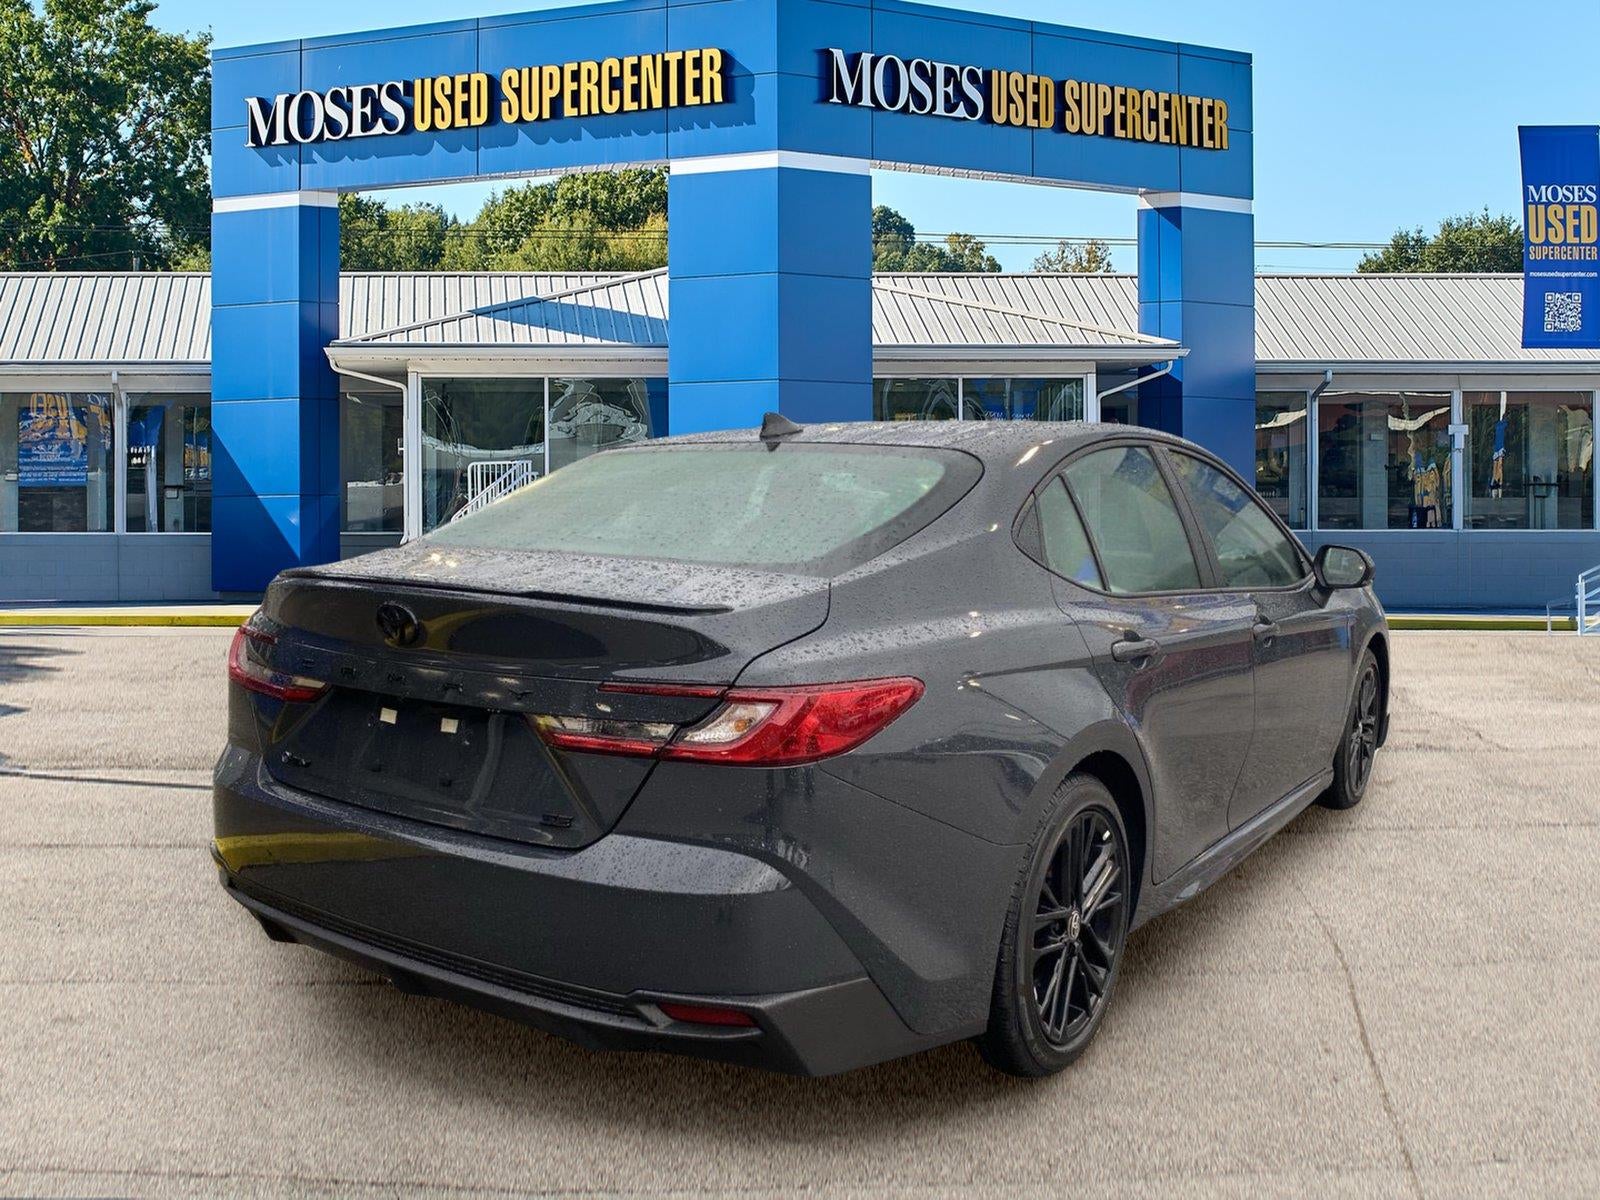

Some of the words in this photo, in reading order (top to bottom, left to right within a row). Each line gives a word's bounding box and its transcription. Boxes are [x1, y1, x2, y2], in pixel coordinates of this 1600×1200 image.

[244, 80, 406, 148] MOSES
[414, 72, 489, 132] USED
[500, 47, 725, 124] SUPERCENTER
[829, 48, 984, 121] MOSES
[991, 69, 1055, 129] USED
[1064, 79, 1229, 151] SUPERCENTER
[1527, 185, 1597, 203] MOSES
[1528, 204, 1597, 244] USED
[1529, 246, 1598, 260] SUPERCENTER
